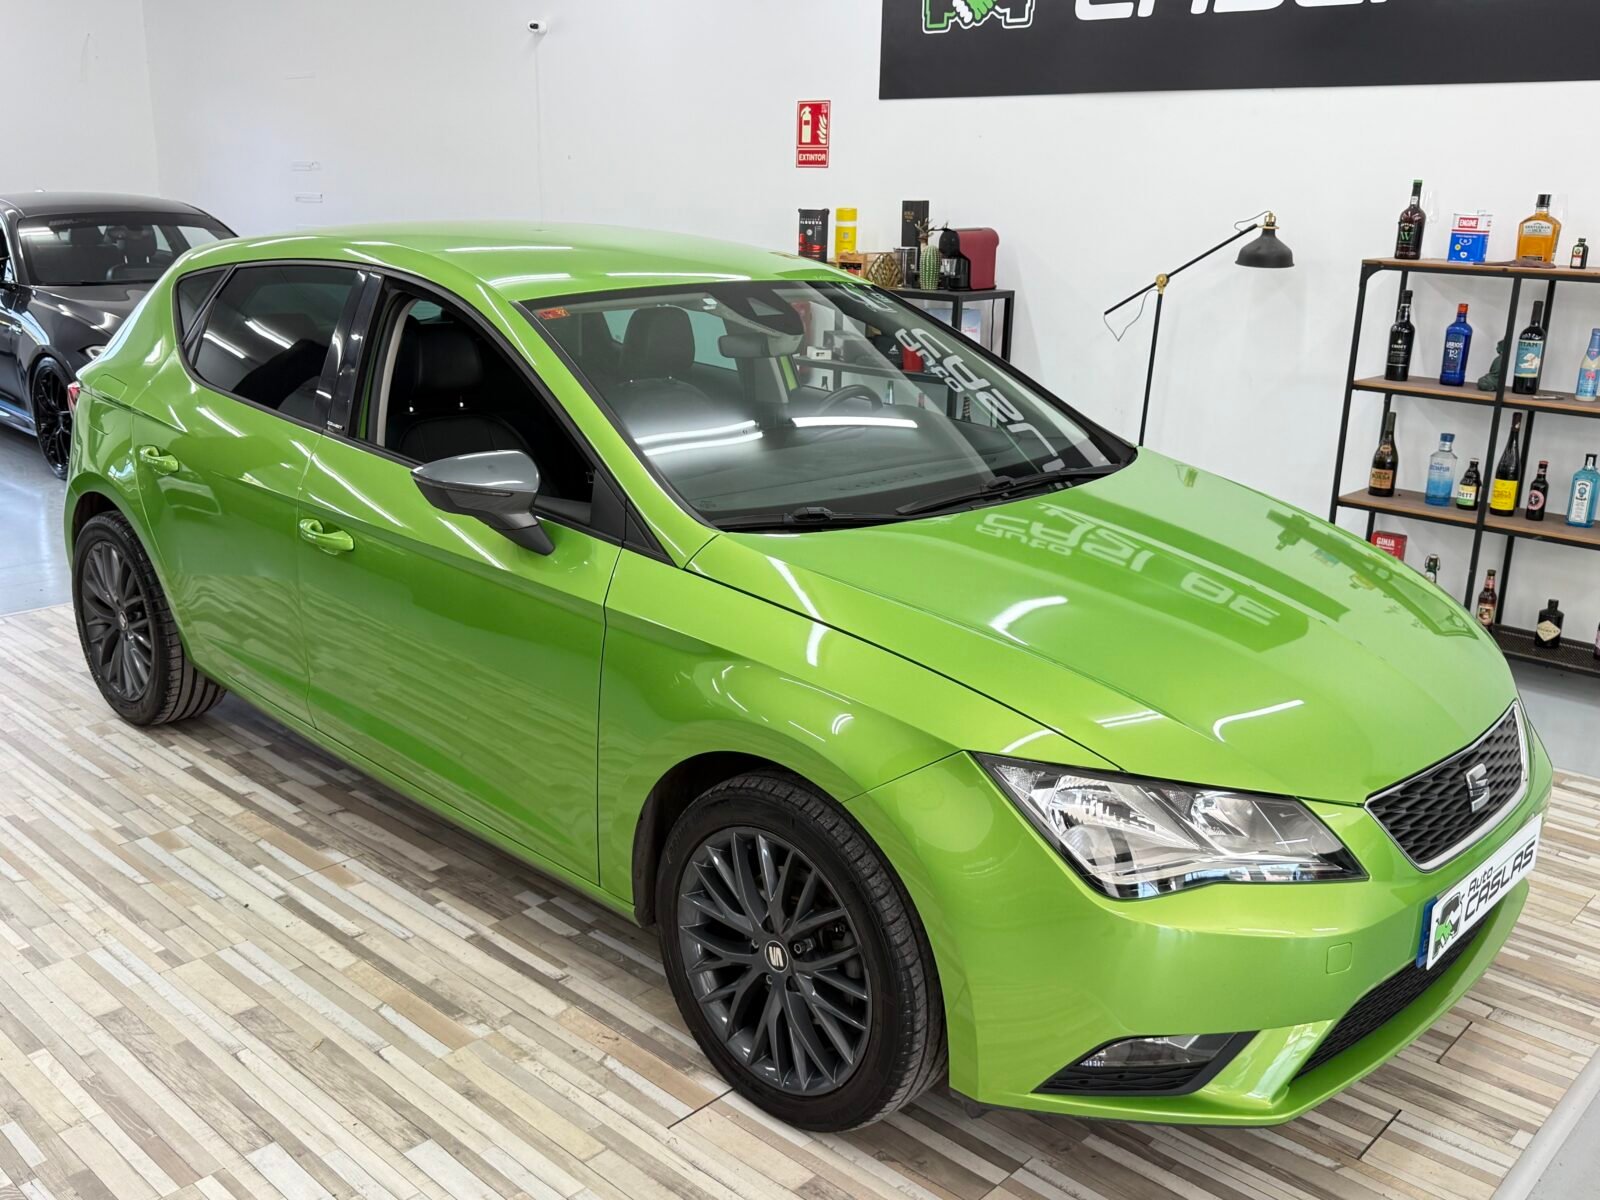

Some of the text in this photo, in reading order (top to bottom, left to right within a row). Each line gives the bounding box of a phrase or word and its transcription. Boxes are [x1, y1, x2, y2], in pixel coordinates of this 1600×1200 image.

[798, 153, 826, 162] EXTINTOR
[1459, 219, 1478, 228] ENGINE
[1464, 840, 1536, 921] CASLAS
